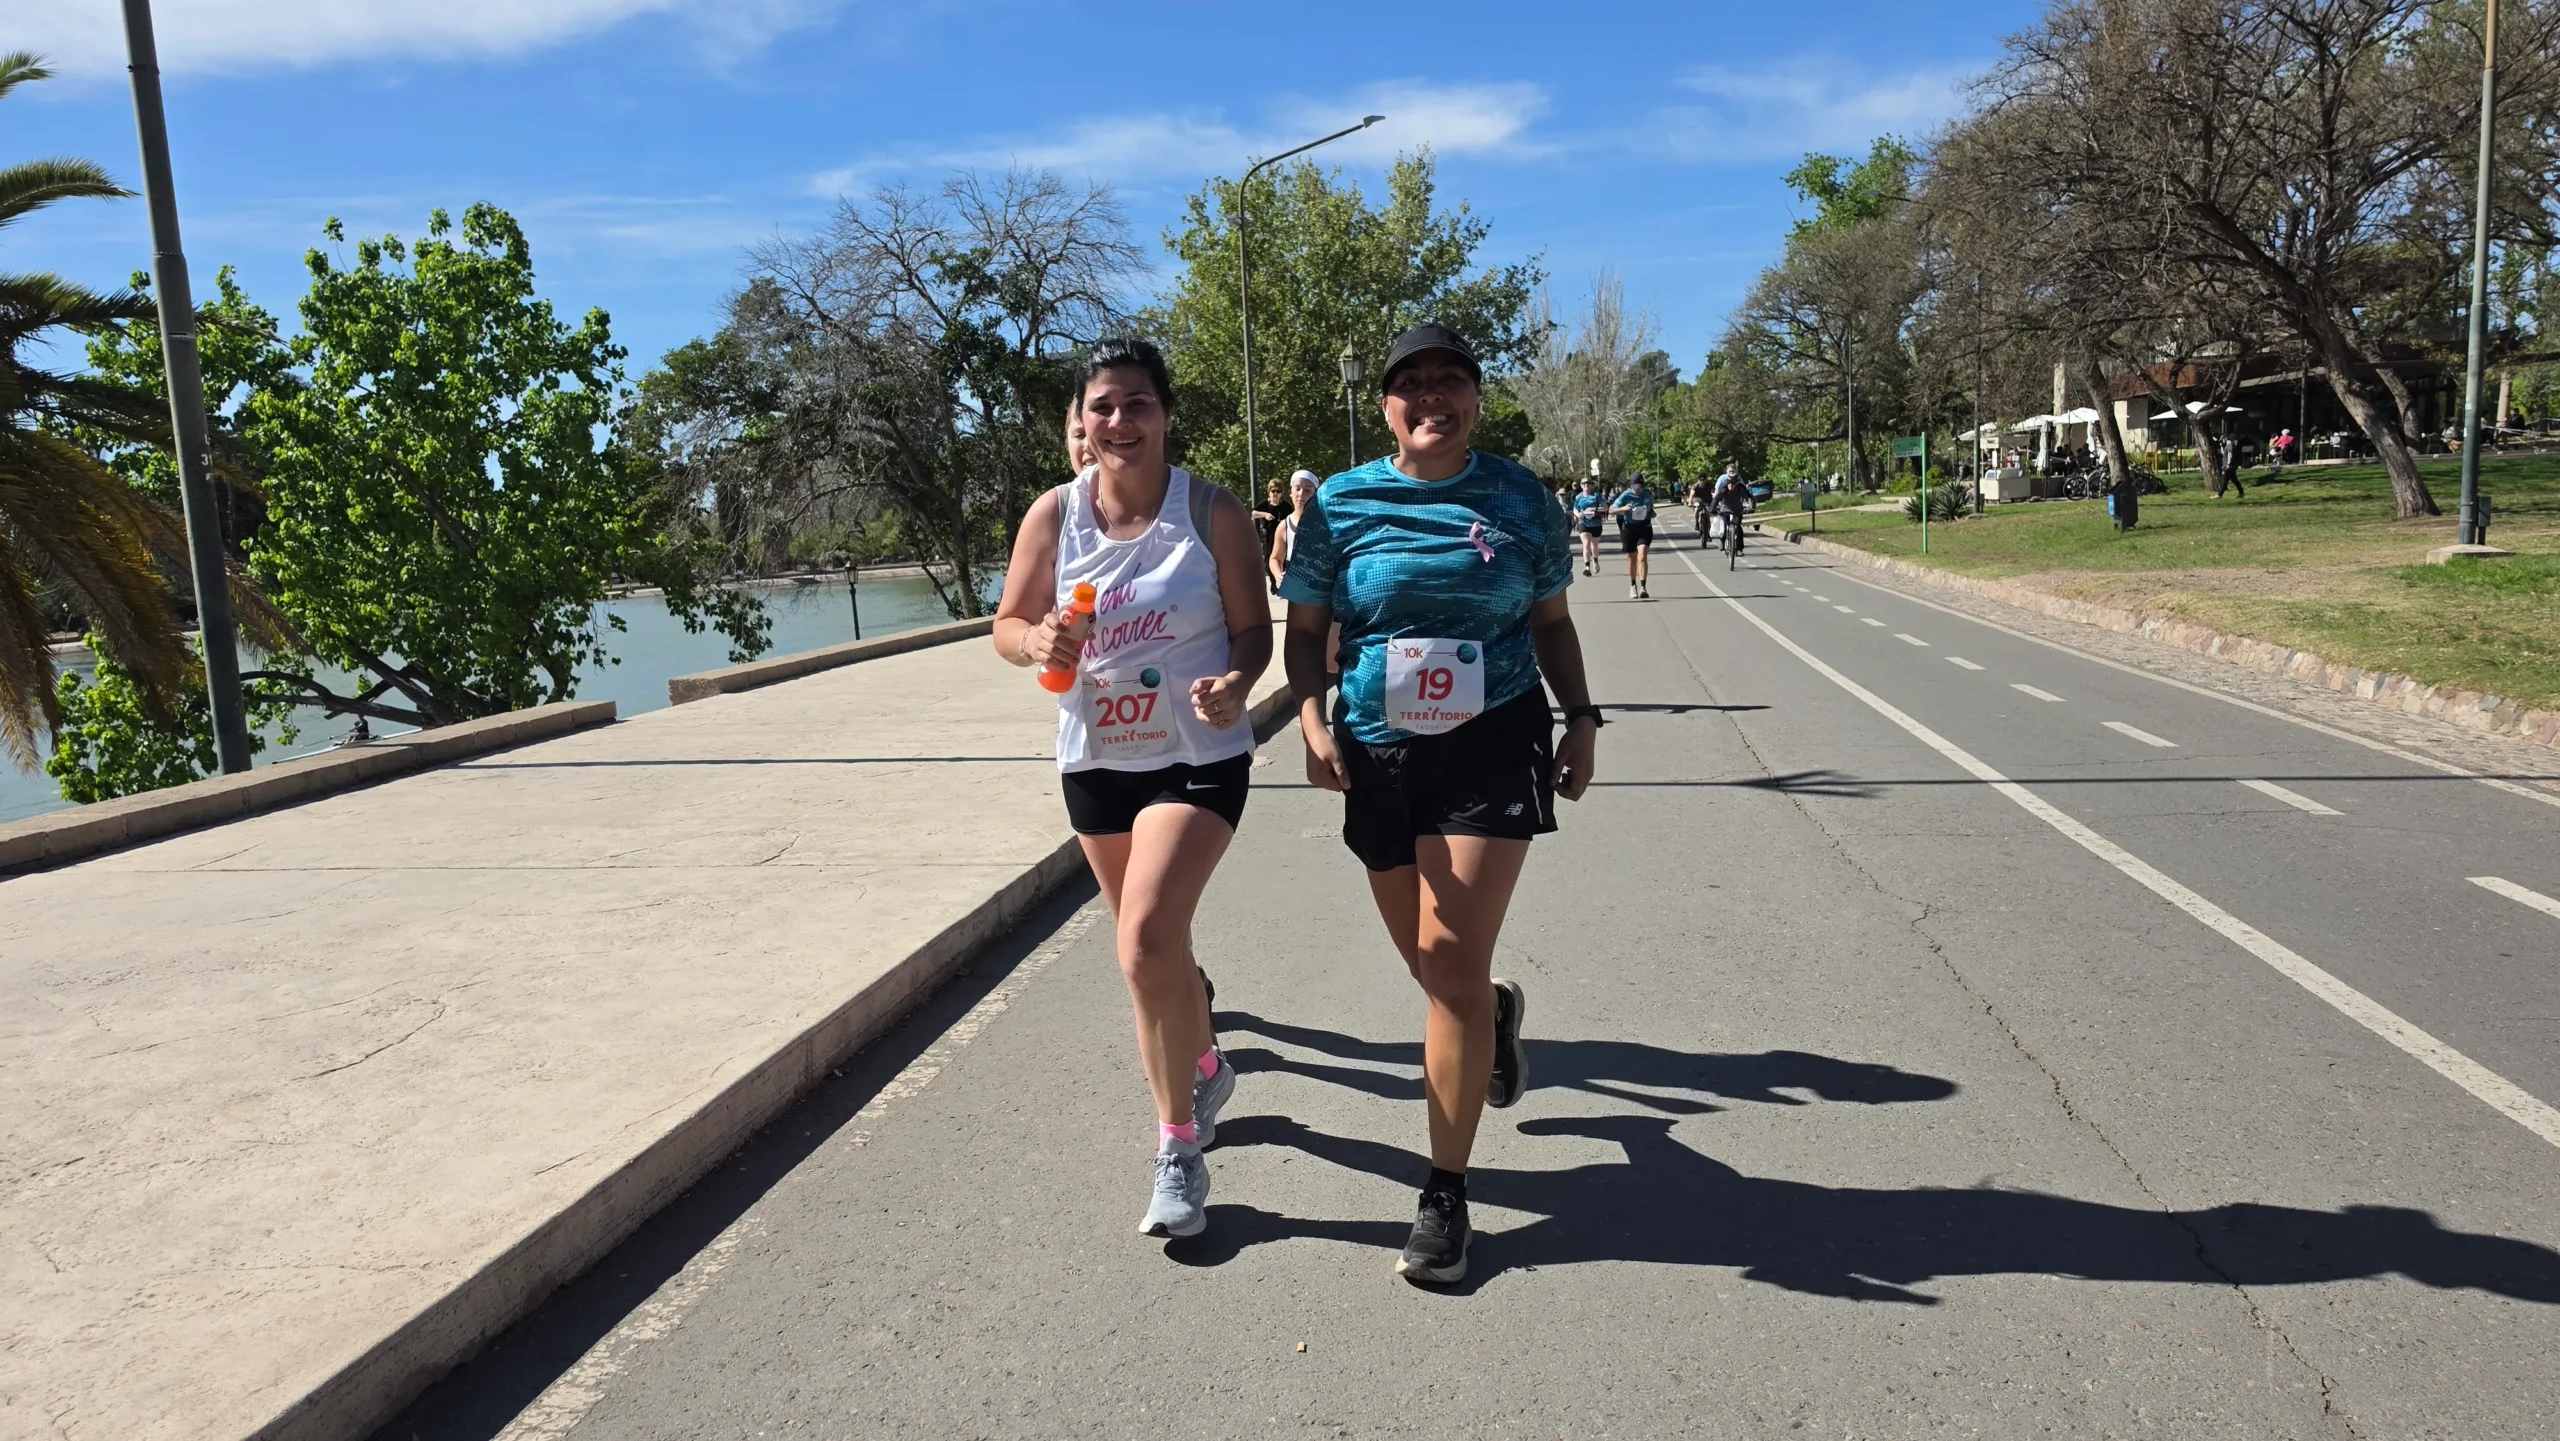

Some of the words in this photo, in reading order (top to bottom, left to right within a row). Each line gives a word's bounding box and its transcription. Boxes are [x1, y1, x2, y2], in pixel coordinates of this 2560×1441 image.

[1403, 647, 1424, 659] 10k
[1094, 678, 1112, 689] 10k
[1415, 667, 1454, 701] 19
[1095, 692, 1159, 728] 207
